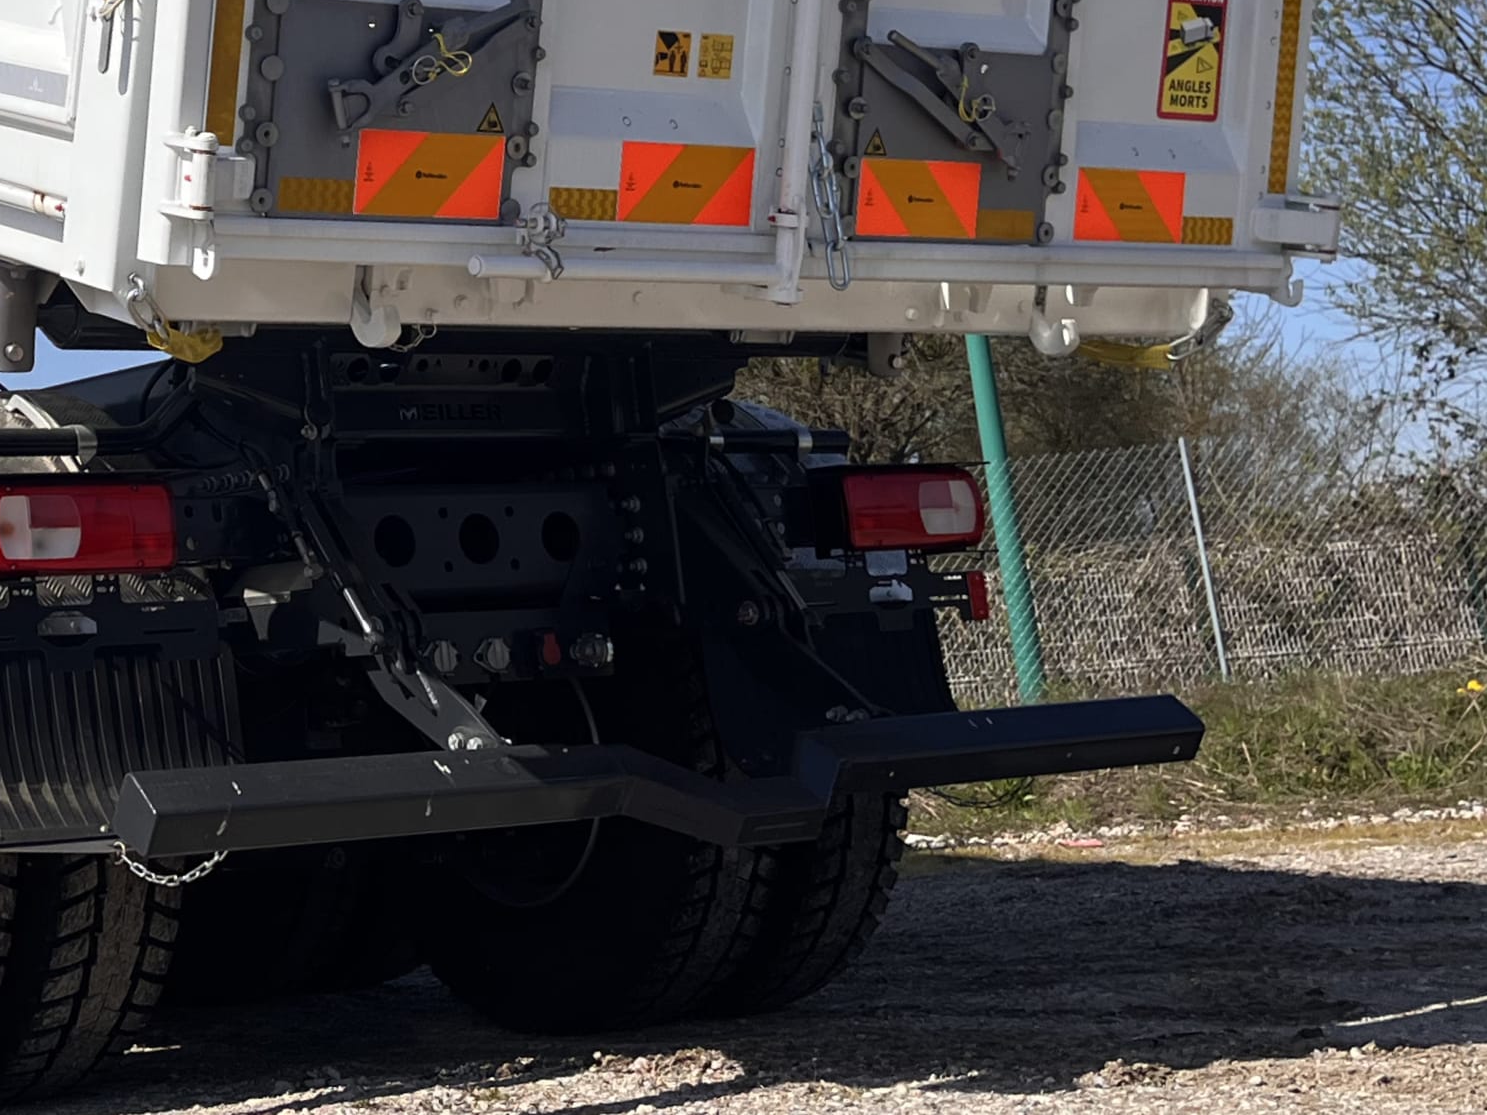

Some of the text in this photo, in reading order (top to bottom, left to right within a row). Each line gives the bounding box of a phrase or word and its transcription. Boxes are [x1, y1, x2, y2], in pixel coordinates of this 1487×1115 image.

[1168, 78, 1212, 94] ANGLES
[1169, 94, 1209, 109] MORTS
[399, 402, 504, 422] MEILLER
